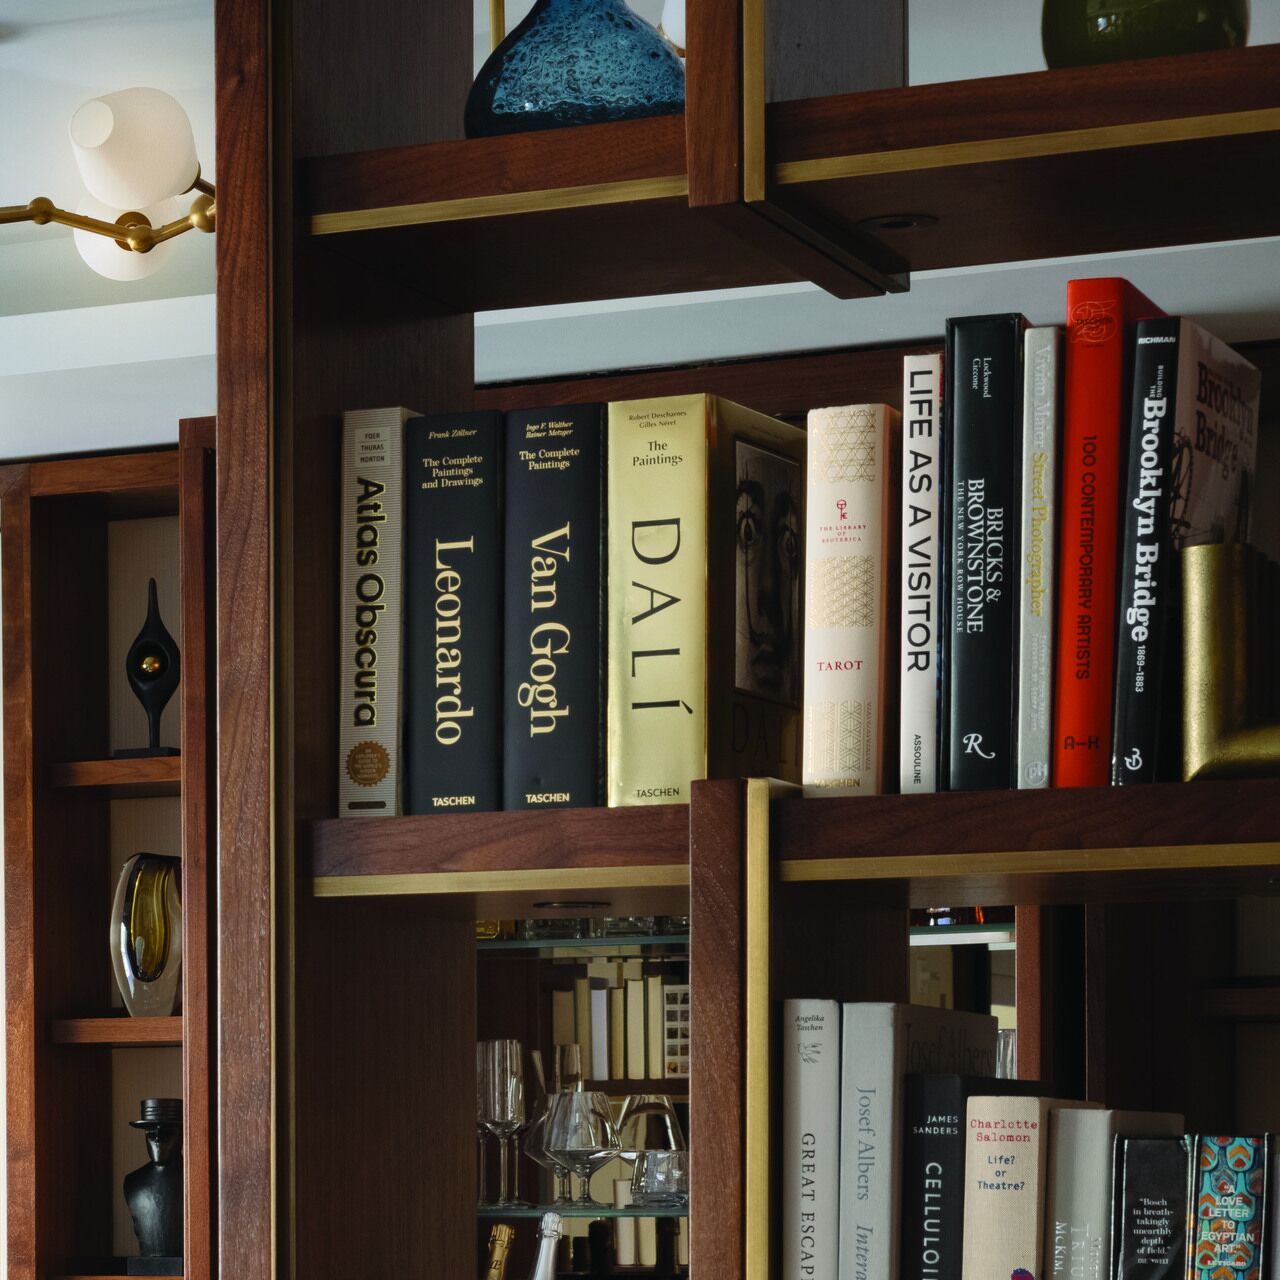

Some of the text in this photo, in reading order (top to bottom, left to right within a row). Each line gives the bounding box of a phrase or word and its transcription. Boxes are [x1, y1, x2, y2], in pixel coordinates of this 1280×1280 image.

[1138, 336, 1176, 344] RICHMAN
[972, 358, 980, 389] Ciccone
[983, 357, 992, 398] Lockwood
[647, 440, 668, 452] The
[519, 448, 580, 461] The Complete
[632, 453, 683, 468] Paintings
[423, 455, 483, 468] The Complete
[528, 459, 571, 471] Paintings
[432, 466, 473, 479] Paintings
[1031, 451, 1048, 501] Street
[421, 476, 484, 489] and Drawings
[957, 481, 965, 502] THE
[356, 476, 386, 567] Atlas
[907, 369, 933, 673] LIFE AS A VISITOR
[957, 507, 965, 530] NEW
[1126, 396, 1167, 642] Brooklyn Bridge
[967, 478, 984, 633] BROWNSTONE
[986, 508, 1003, 603] BRICKS &
[1026, 506, 1048, 617] Photographer
[1076, 435, 1096, 680] 100 CONTEMPORARY ARTISTS
[631, 517, 693, 715] DALÍ
[956, 597, 964, 633] HOUSE
[518, 523, 571, 738] Van Gogh
[435, 535, 474, 745] Leonardo
[354, 574, 385, 727] Obscura
[816, 659, 863, 672] TAROT
[913, 734, 921, 784] ASSOULINE
[526, 792, 570, 804] TASCHEN
[636, 787, 680, 798] TASCHEN
[432, 796, 475, 807] TASCHEN
[927, 1115, 959, 1124] JAMES
[970, 1119, 1038, 1131] Charlotte
[912, 1126, 958, 1135] SANDERS
[976, 1131, 1031, 1143] Salomon
[856, 1087, 877, 1202] Josef Albers
[802, 1132, 816, 1201] GREAT
[987, 1155, 1016, 1165] Life?
[995, 1169, 1007, 1177] or
[977, 1180, 1025, 1191] Theatre?
[1215, 1197, 1243, 1206] LOVE
[1209, 1208, 1249, 1218] LETTER
[1137, 1218, 1169, 1227] takingly
[1222, 1220, 1235, 1228] TO
[1141, 1238, 1164, 1246] depth
[1201, 1231, 1254, 1242] EGYPTIAN
